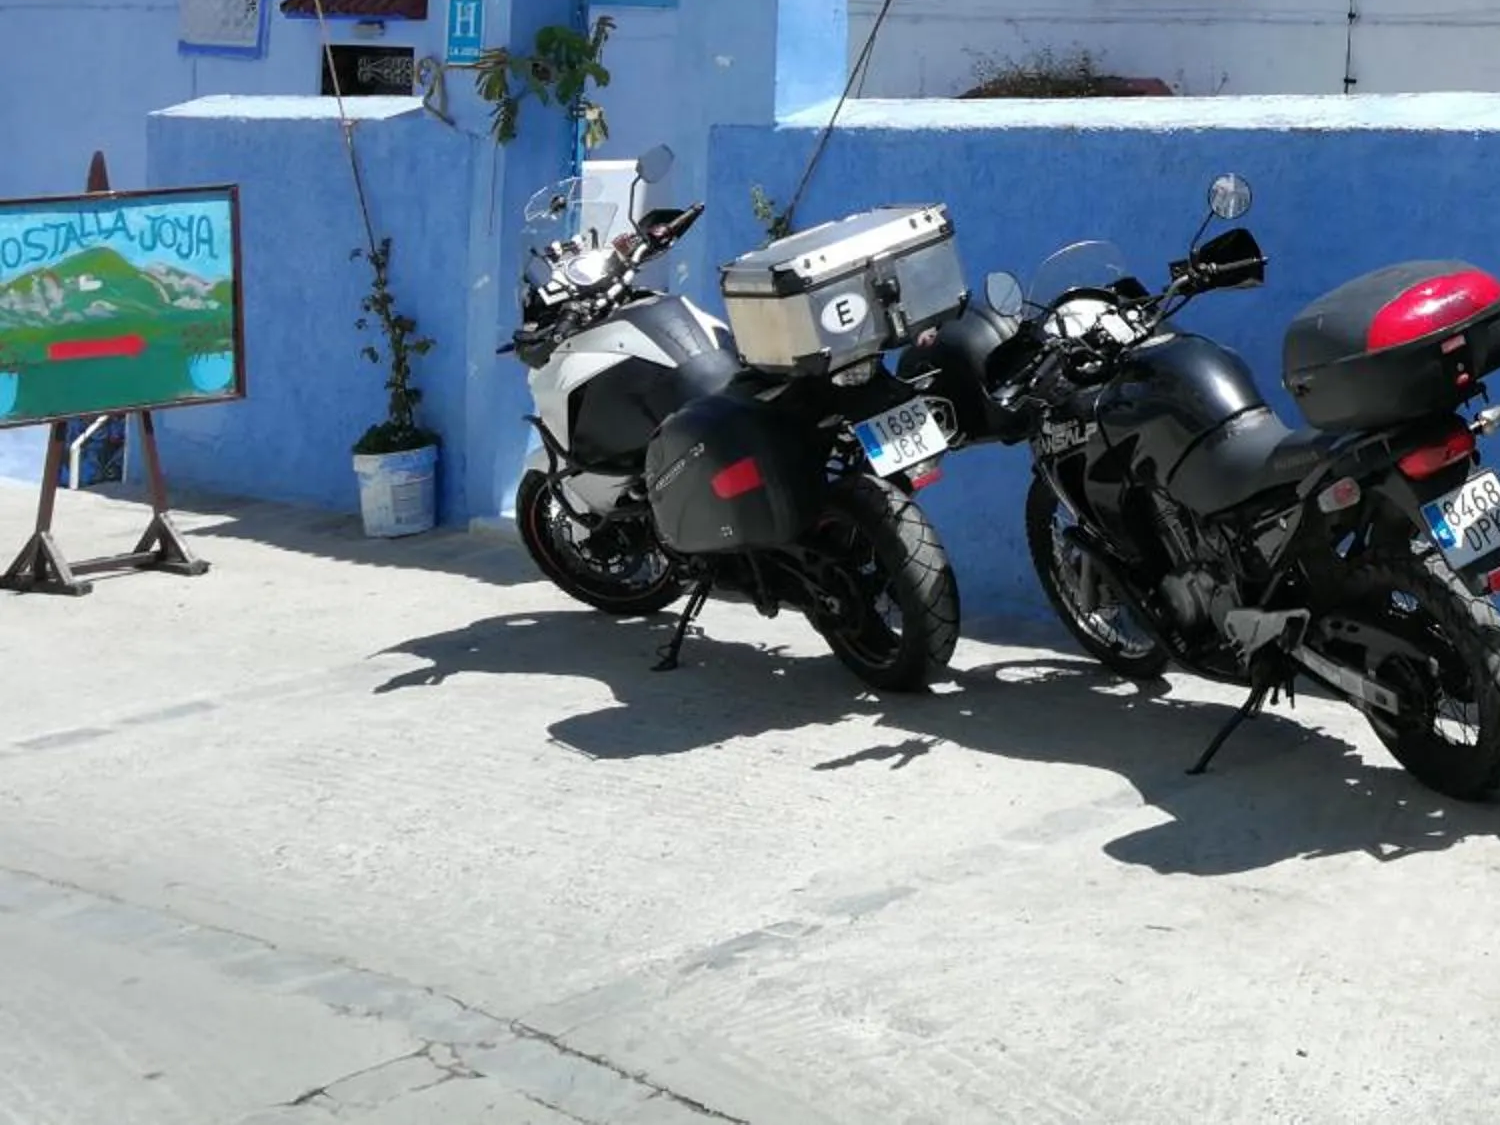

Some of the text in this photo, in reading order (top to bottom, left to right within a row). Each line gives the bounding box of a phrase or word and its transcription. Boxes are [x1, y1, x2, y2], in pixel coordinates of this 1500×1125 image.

[452, 2, 477, 37] H
[0, 209, 219, 273] OSTAL LA JOYA
[836, 298, 854, 327] E
[875, 404, 927, 443] 1695
[893, 433, 929, 464] JCR
[1443, 480, 1500, 527] 8468
